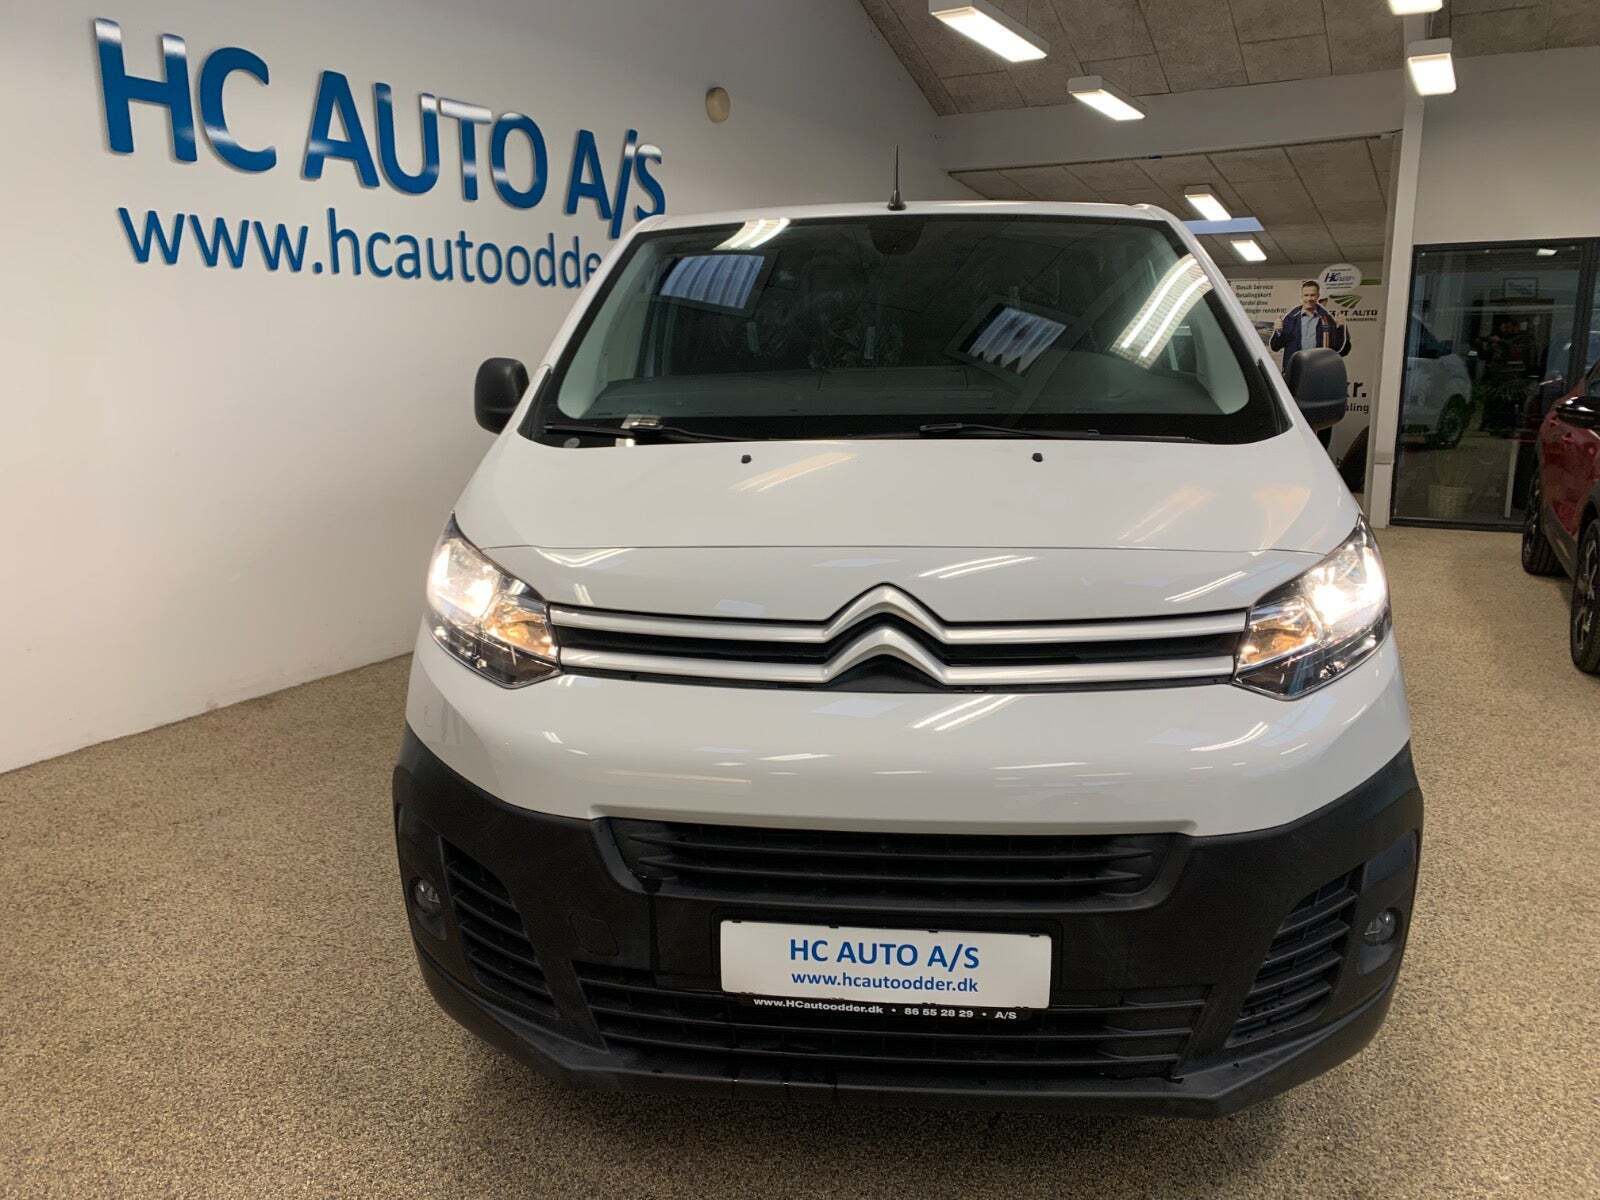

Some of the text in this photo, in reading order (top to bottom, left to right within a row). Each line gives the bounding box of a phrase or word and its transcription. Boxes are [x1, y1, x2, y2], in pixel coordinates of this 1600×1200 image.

[94, 18, 666, 239] HC AUTO A/S
[117, 207, 601, 289] www.hcautoodde
[1352, 309, 1378, 317] AUTO
[790, 939, 980, 973] HC AUTO A/S
[791, 971, 978, 993] www.hcautoodder.dk
[753, 999, 1017, 1020] www.HCautoodder.dk 86 55 28 29 A/S
